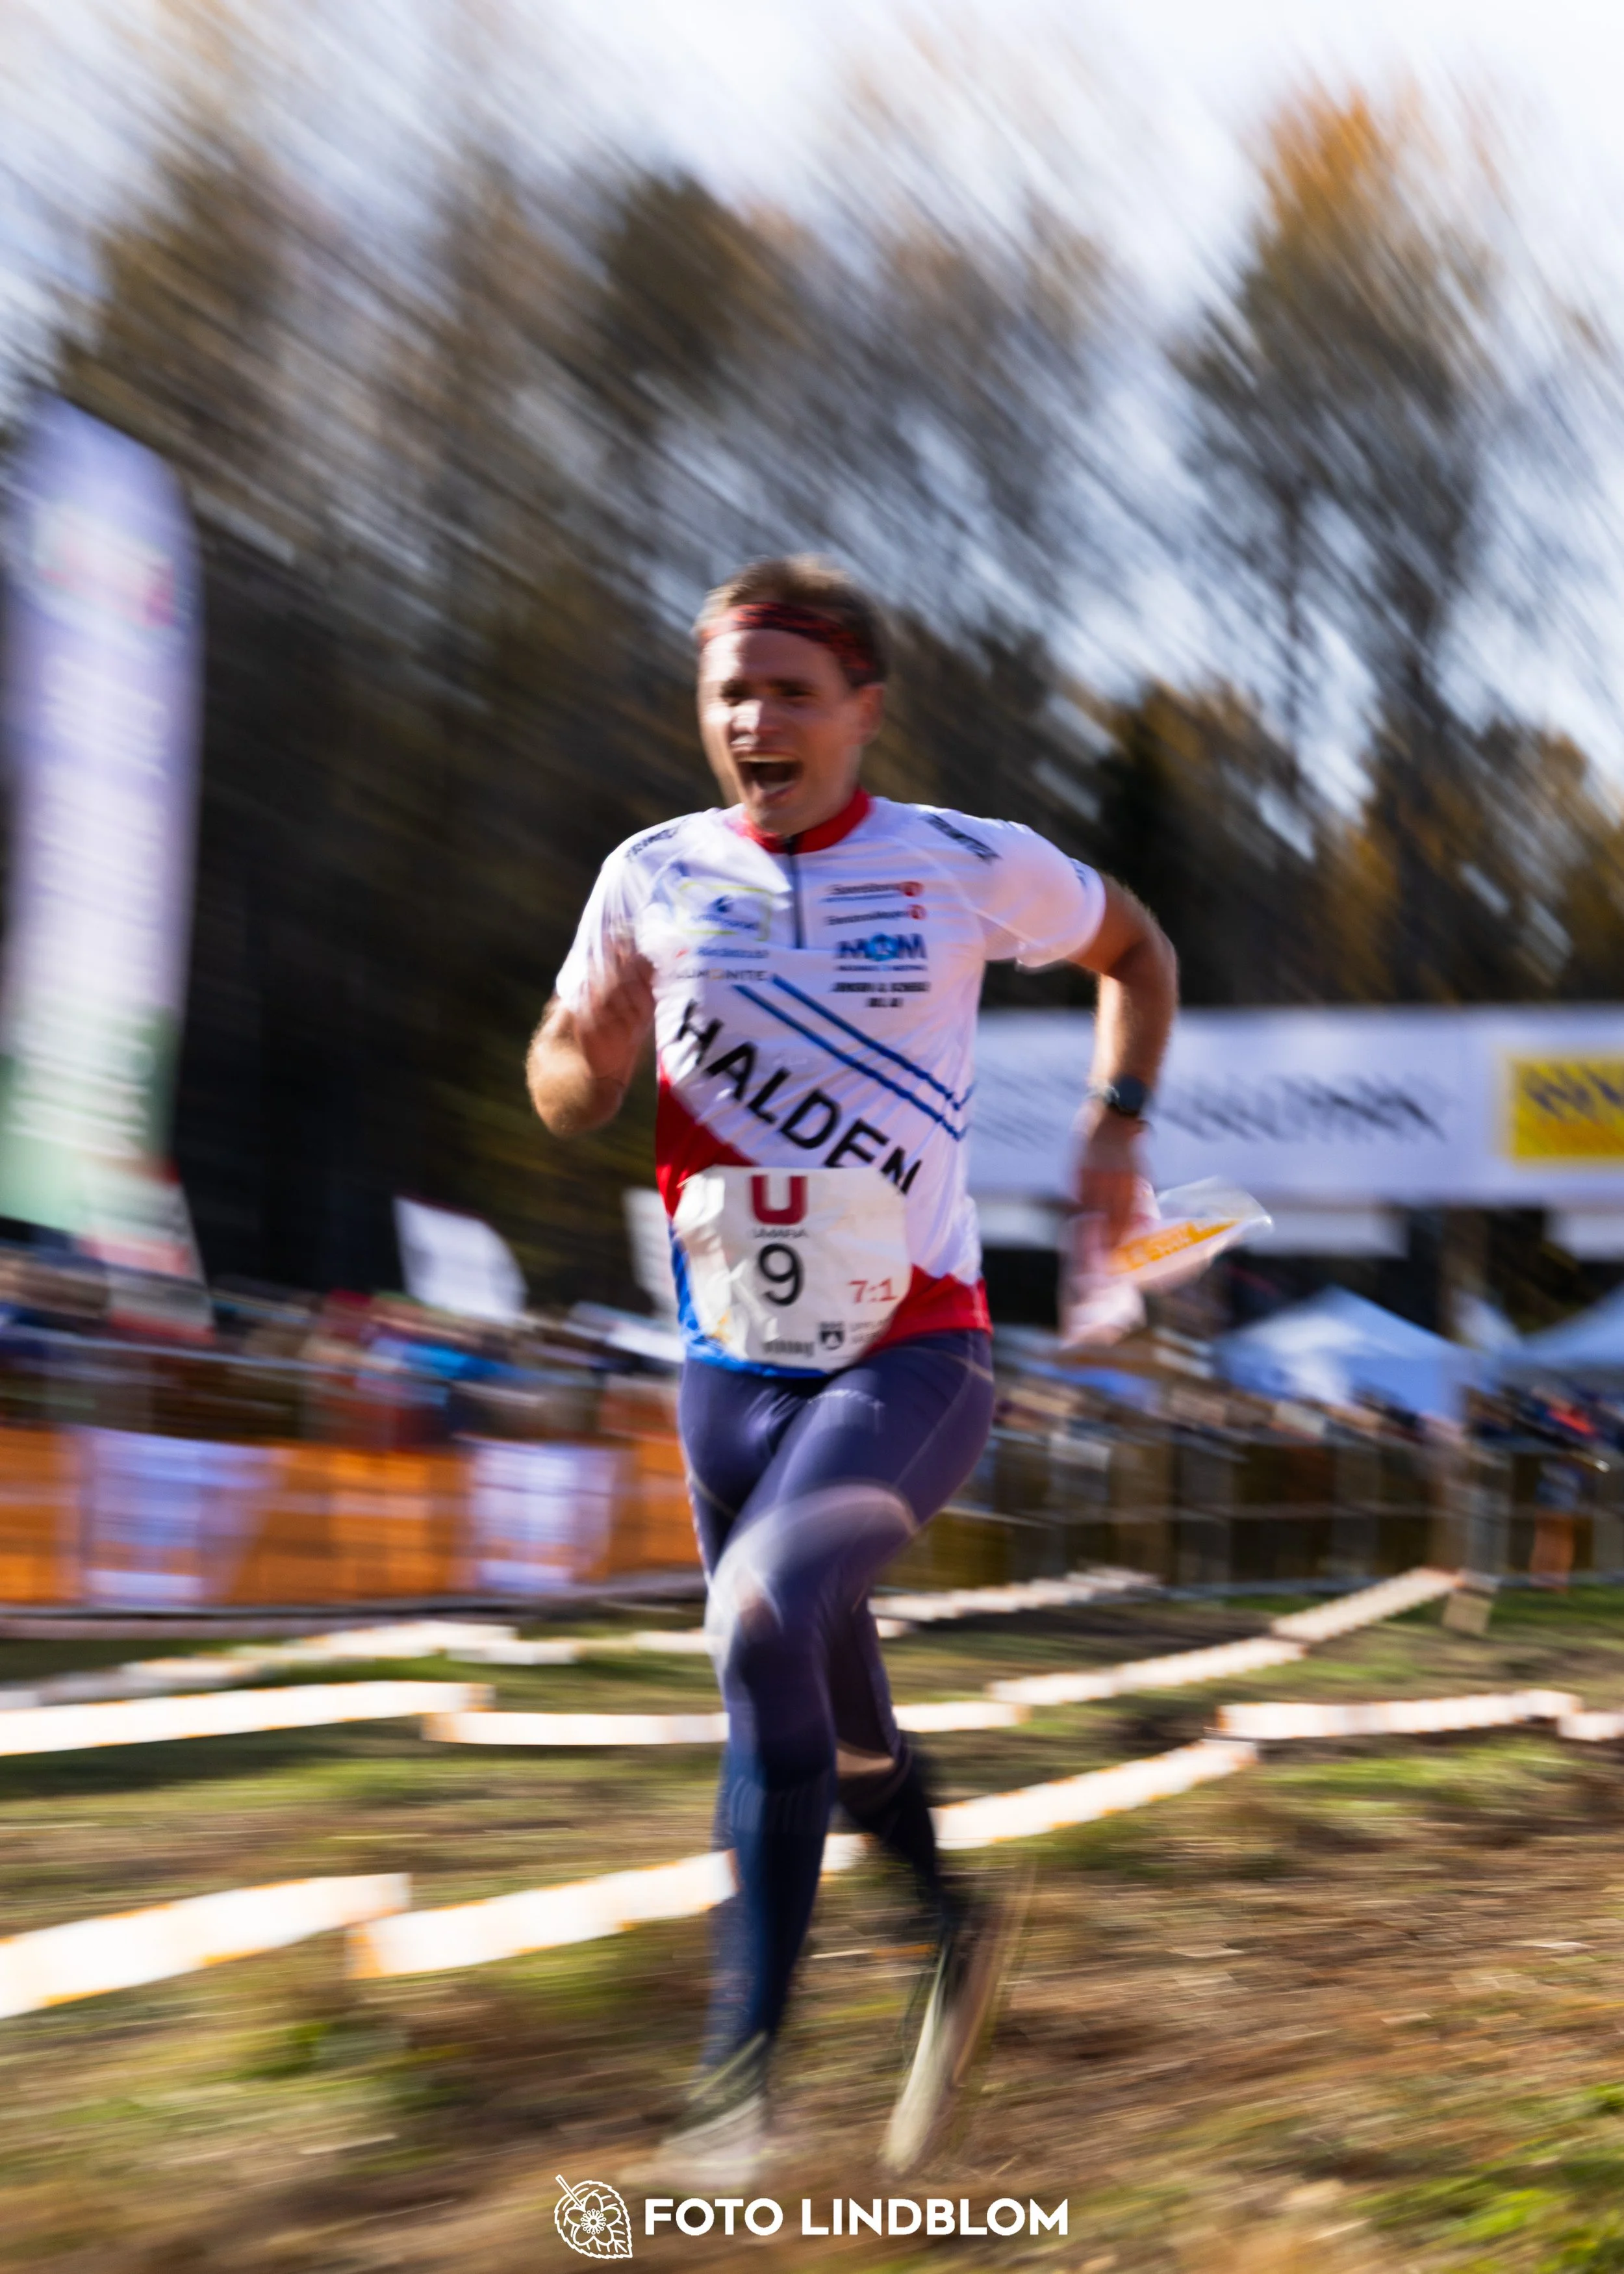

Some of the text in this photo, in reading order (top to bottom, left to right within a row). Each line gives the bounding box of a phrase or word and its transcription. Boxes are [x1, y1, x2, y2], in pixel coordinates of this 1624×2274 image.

[676, 999, 922, 1195] HALDEN
[757, 1243, 804, 1306] 9
[847, 1278, 896, 1304] 7:1
